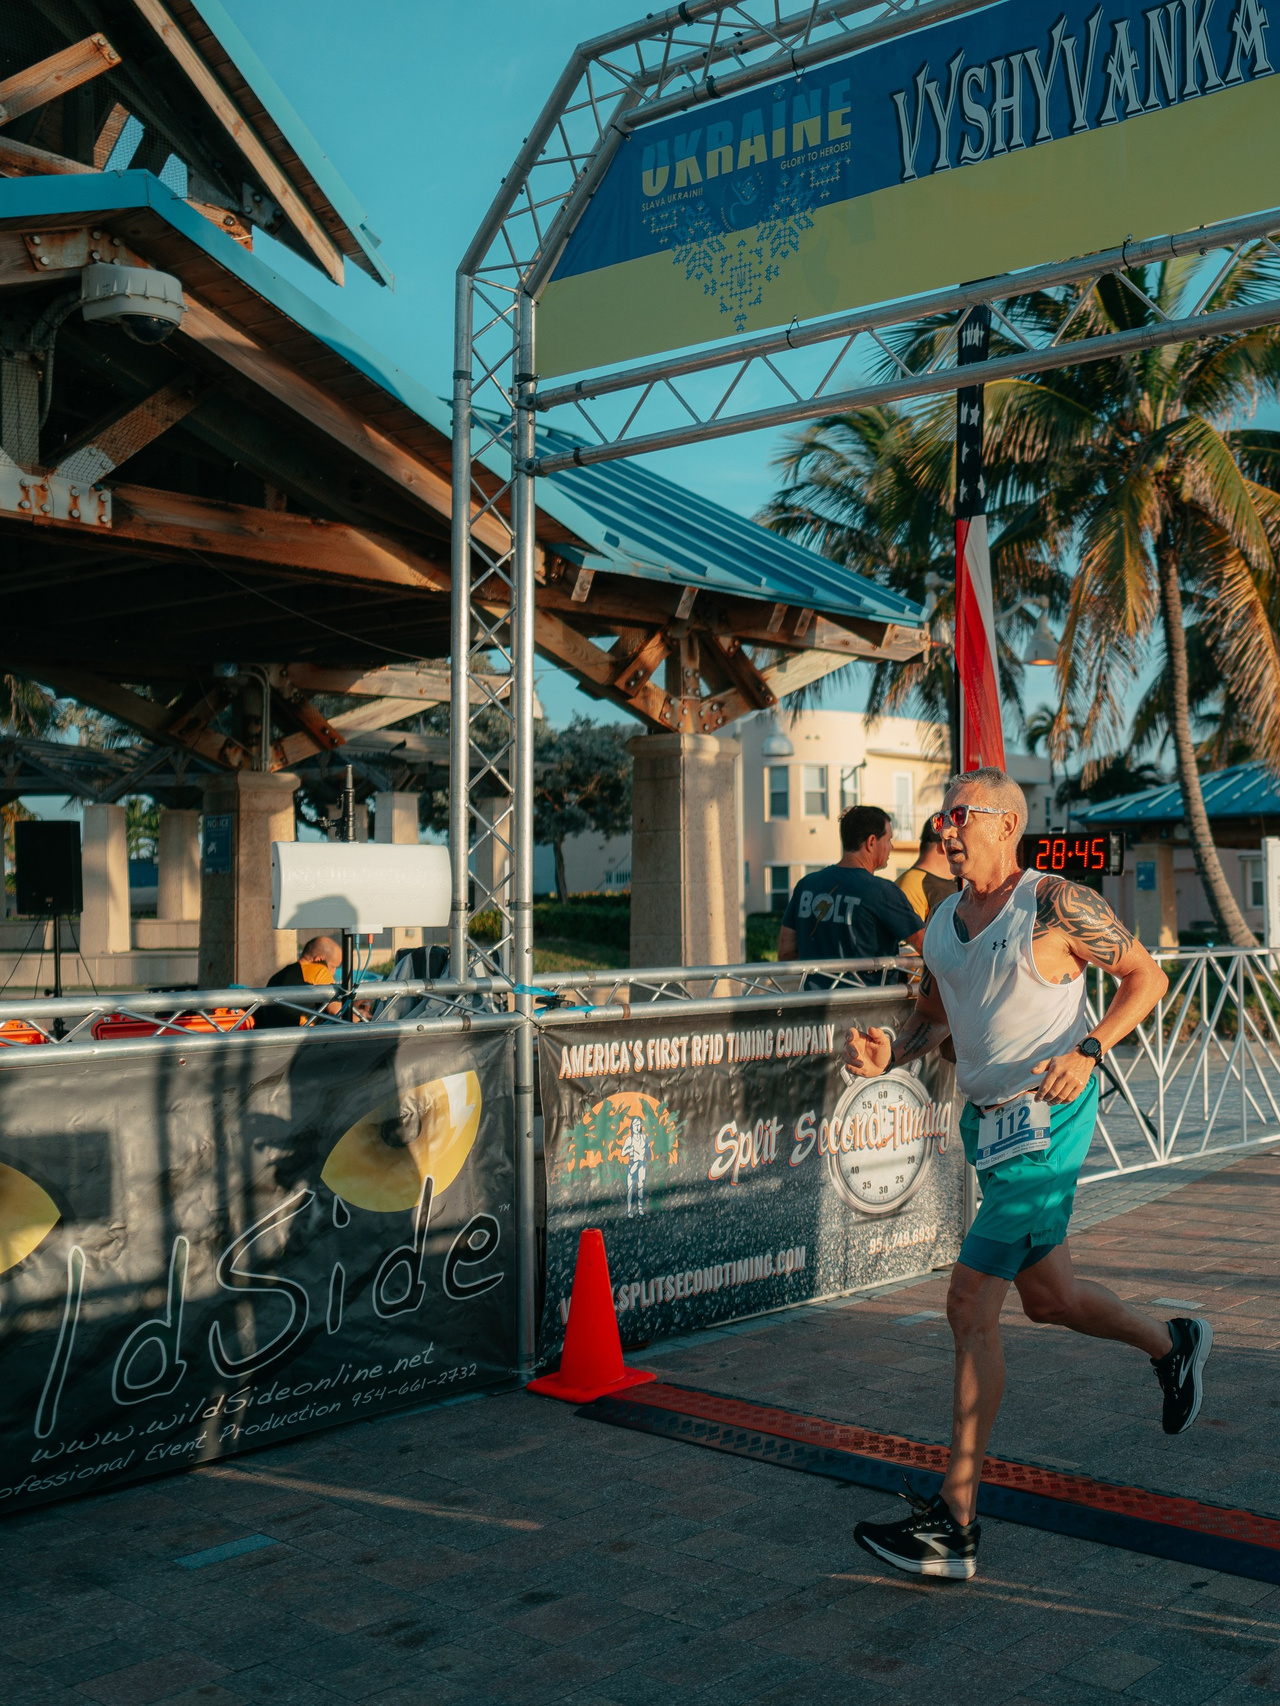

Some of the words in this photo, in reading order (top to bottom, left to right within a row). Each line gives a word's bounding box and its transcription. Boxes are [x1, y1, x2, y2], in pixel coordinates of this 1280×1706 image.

[893, 0, 1275, 184] VYSHYVANKA
[641, 77, 852, 198] UKRAINE
[780, 155, 805, 170] GLORY
[807, 150, 818, 162] TO
[820, 140, 852, 158] HEROES!
[641, 197, 666, 212] SLAVA
[667, 187, 704, 204] UKRAINI!
[206, 818, 229, 829] NOICE
[1035, 838, 1105, 870] 28:45
[798, 889, 861, 926] BOLT
[558, 1038, 644, 1080] AMERICA'S
[646, 1032, 689, 1071] FIRST
[691, 1031, 724, 1068] RFID
[726, 1027, 774, 1063] TIMING
[775, 1023, 836, 1058] COMPANY
[862, 1100, 872, 1110] 55
[878, 1090, 888, 1100] 60
[995, 1105, 1031, 1141] 112
[708, 1116, 784, 1187] Split
[788, 1099, 882, 1168] Second
[888, 1097, 952, 1156] Timing
[850, 1165, 860, 1176] 40
[907, 1155, 916, 1166] 20
[862, 1179, 872, 1190] 35
[894, 1174, 904, 1185] 25
[878, 1184, 889, 1195] 30
[560, 1245, 806, 1326] W.SPLITSECONDTIMING.COM
[144, 1430, 207, 1464] Event
[219, 1401, 342, 1444] Production
[352, 1362, 478, 1408] 954-661-2732
